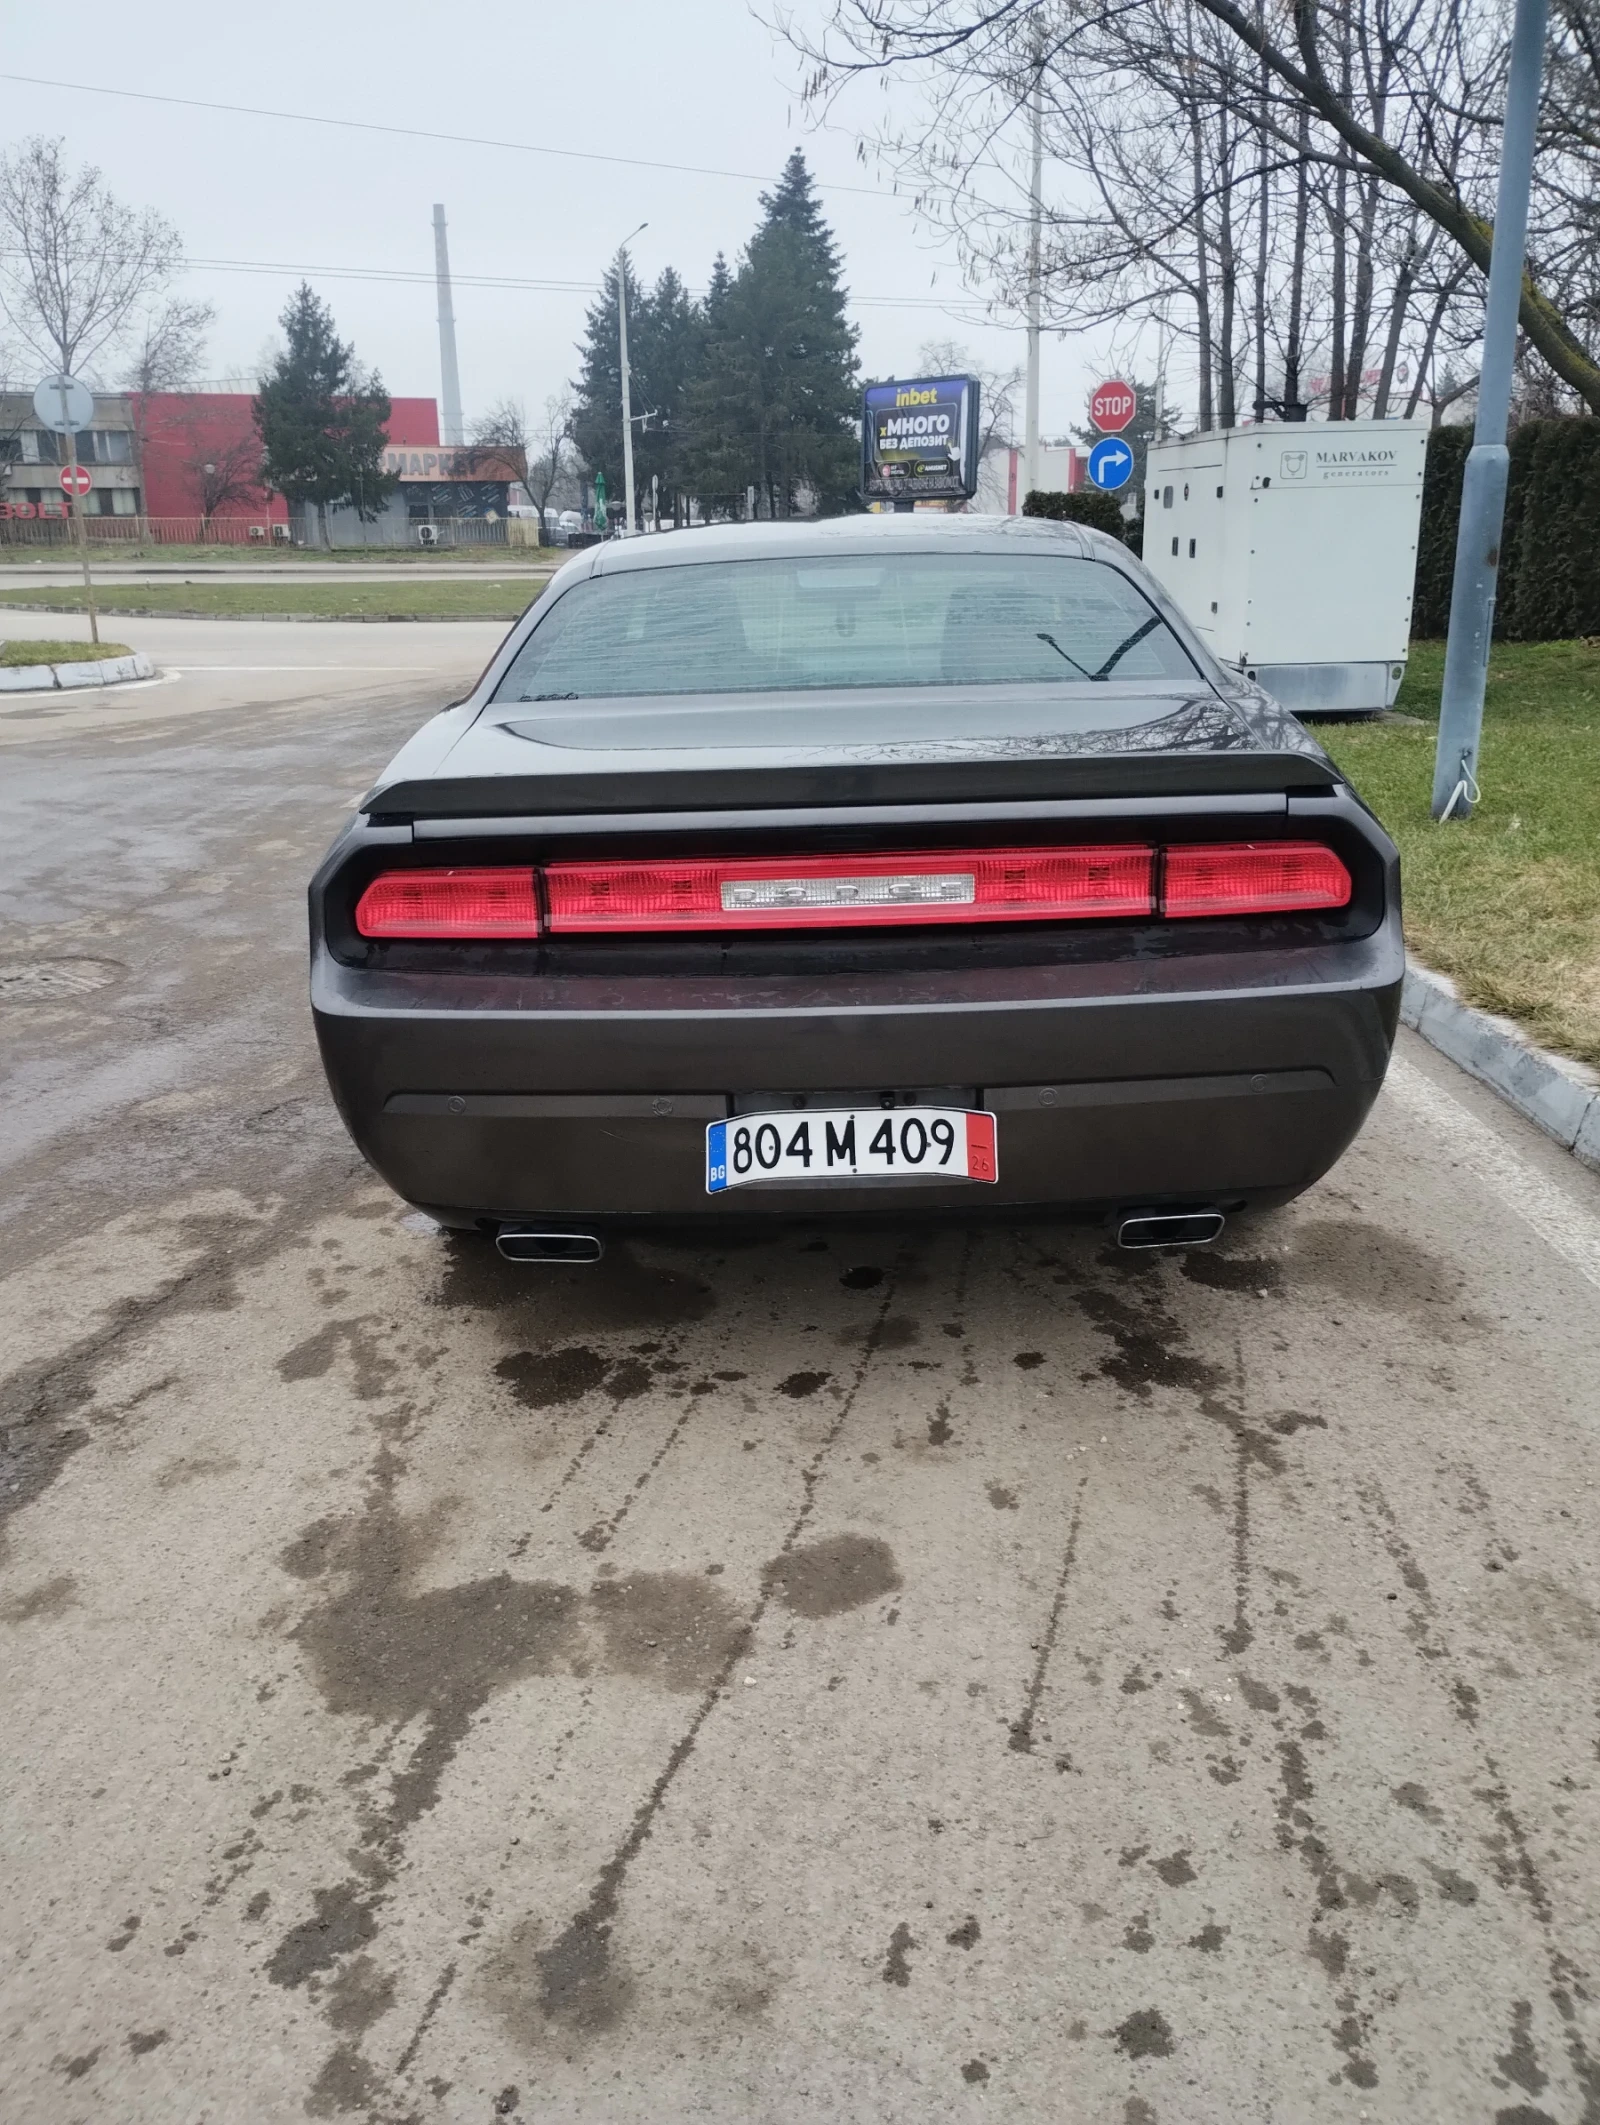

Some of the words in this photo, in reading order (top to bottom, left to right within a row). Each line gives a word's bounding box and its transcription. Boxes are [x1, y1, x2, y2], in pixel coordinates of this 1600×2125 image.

[896, 387, 938, 407] inbet
[1094, 396, 1132, 417] STOP
[879, 438, 898, 450] БЕЗ
[899, 434, 949, 450] ДЕПОЗИТ
[1316, 450, 1397, 463] MARVAKOV
[1323, 469, 1389, 479] generators
[0, 502, 73, 519] BOLT
[733, 881, 963, 904] DODGE
[733, 1121, 813, 1174] 804
[825, 1119, 857, 1167] M
[868, 1117, 955, 1166] 409
[971, 1154, 990, 1173] 26
[710, 1164, 726, 1182] BG
